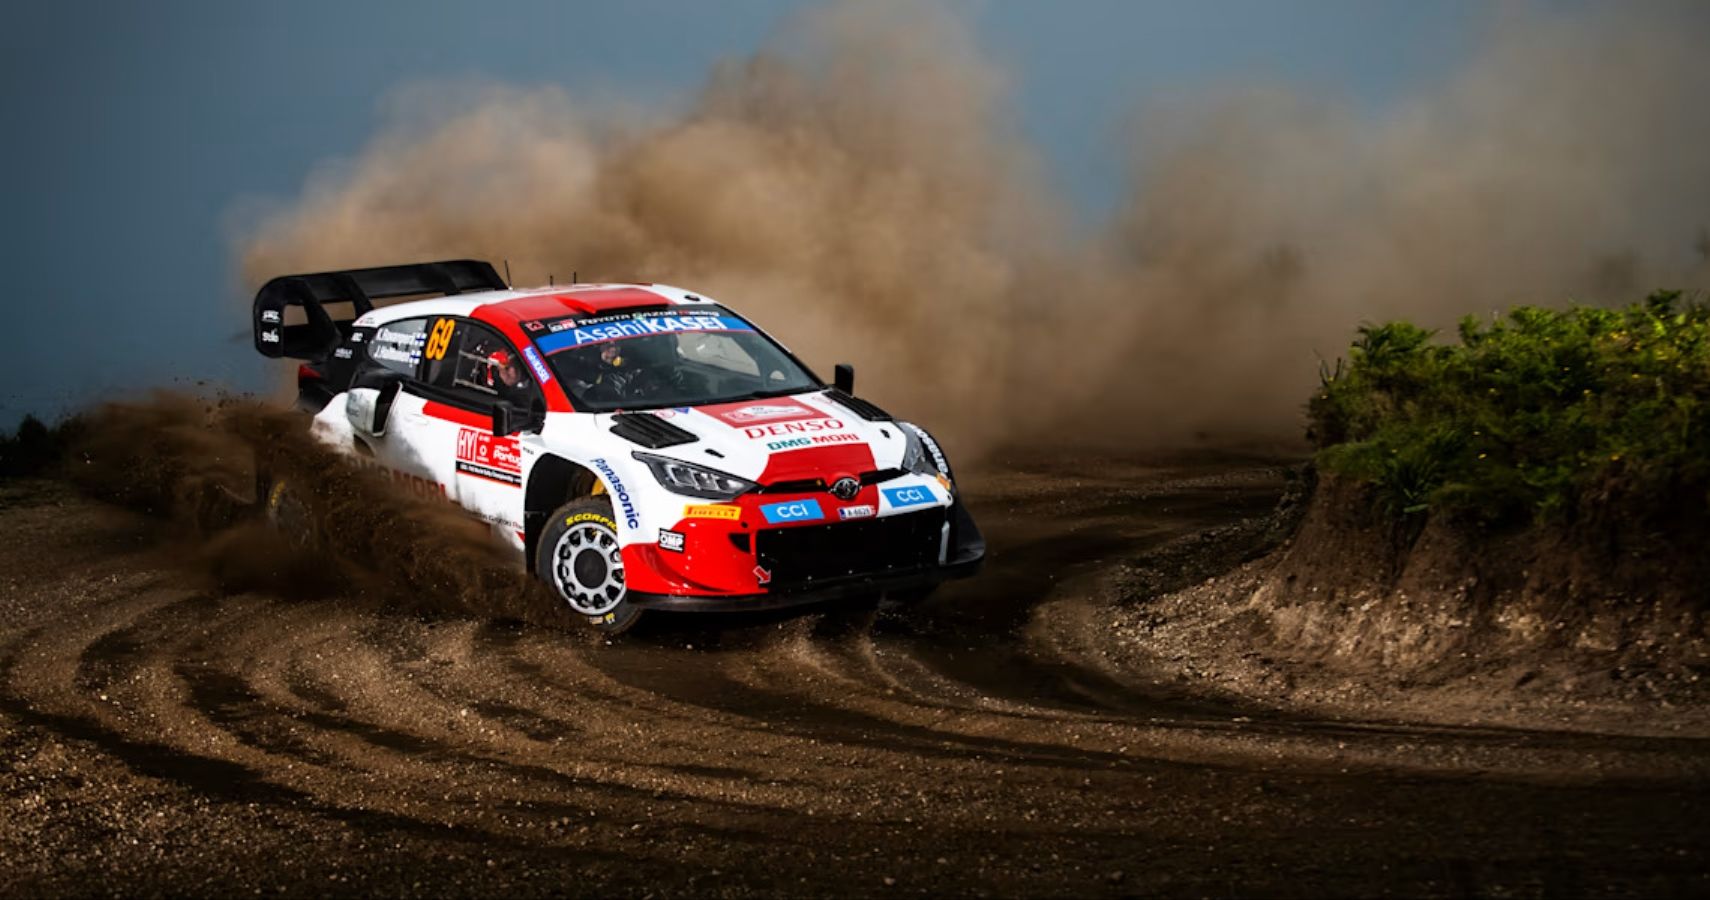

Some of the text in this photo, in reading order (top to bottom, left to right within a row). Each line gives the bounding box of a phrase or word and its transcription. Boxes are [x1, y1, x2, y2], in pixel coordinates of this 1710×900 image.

[577, 314, 630, 325] TOYOTA
[573, 315, 727, 344] AsahiKASEI
[425, 317, 456, 361] 69
[745, 418, 844, 440] DENSO
[458, 430, 476, 459] HY
[766, 433, 860, 451] DMG MORI
[590, 458, 640, 530] Panasonic
[896, 488, 925, 502] CCI
[687, 506, 737, 517] PIRELLI
[776, 502, 809, 519] CCI
[660, 533, 684, 548] OMP
